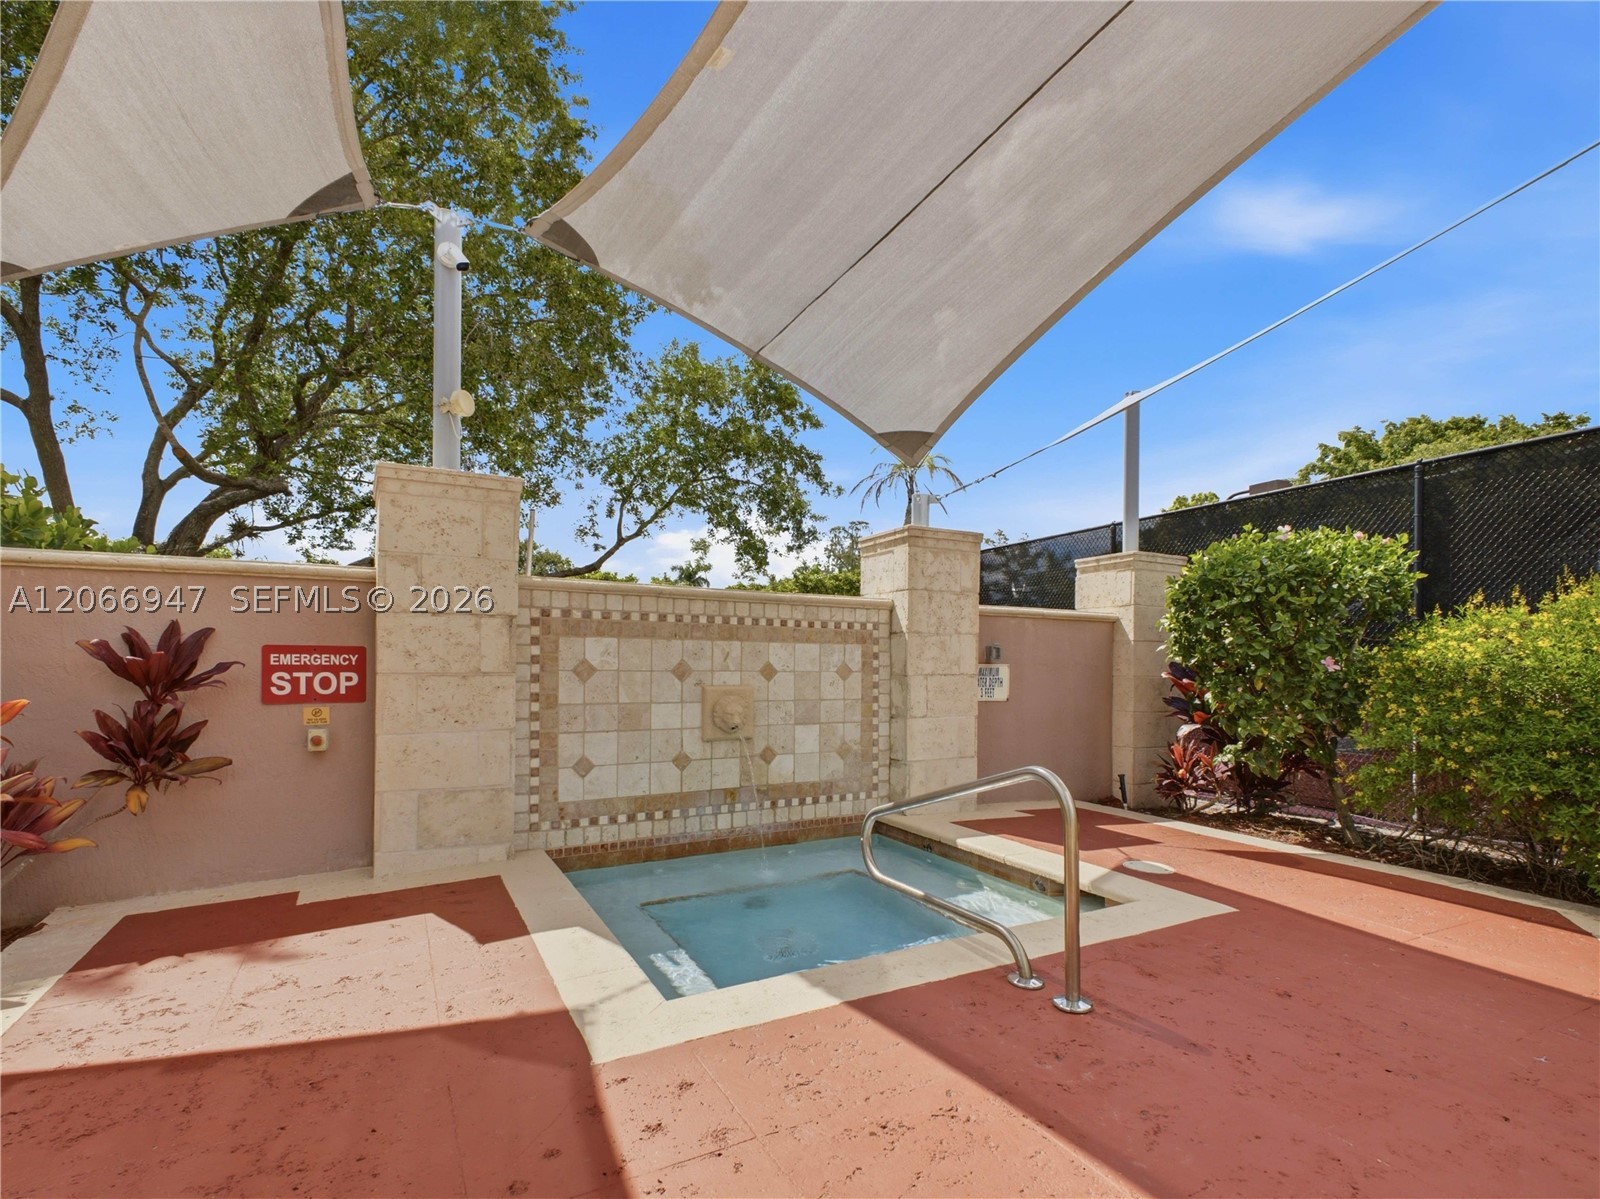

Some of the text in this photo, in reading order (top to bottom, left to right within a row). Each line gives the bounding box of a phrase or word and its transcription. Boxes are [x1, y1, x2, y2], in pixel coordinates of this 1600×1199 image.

[270, 653, 359, 665] EMERGENCY
[269, 671, 359, 696] STOP
[989, 677, 1003, 687] DEPTH
[985, 687, 995, 698] FEET
